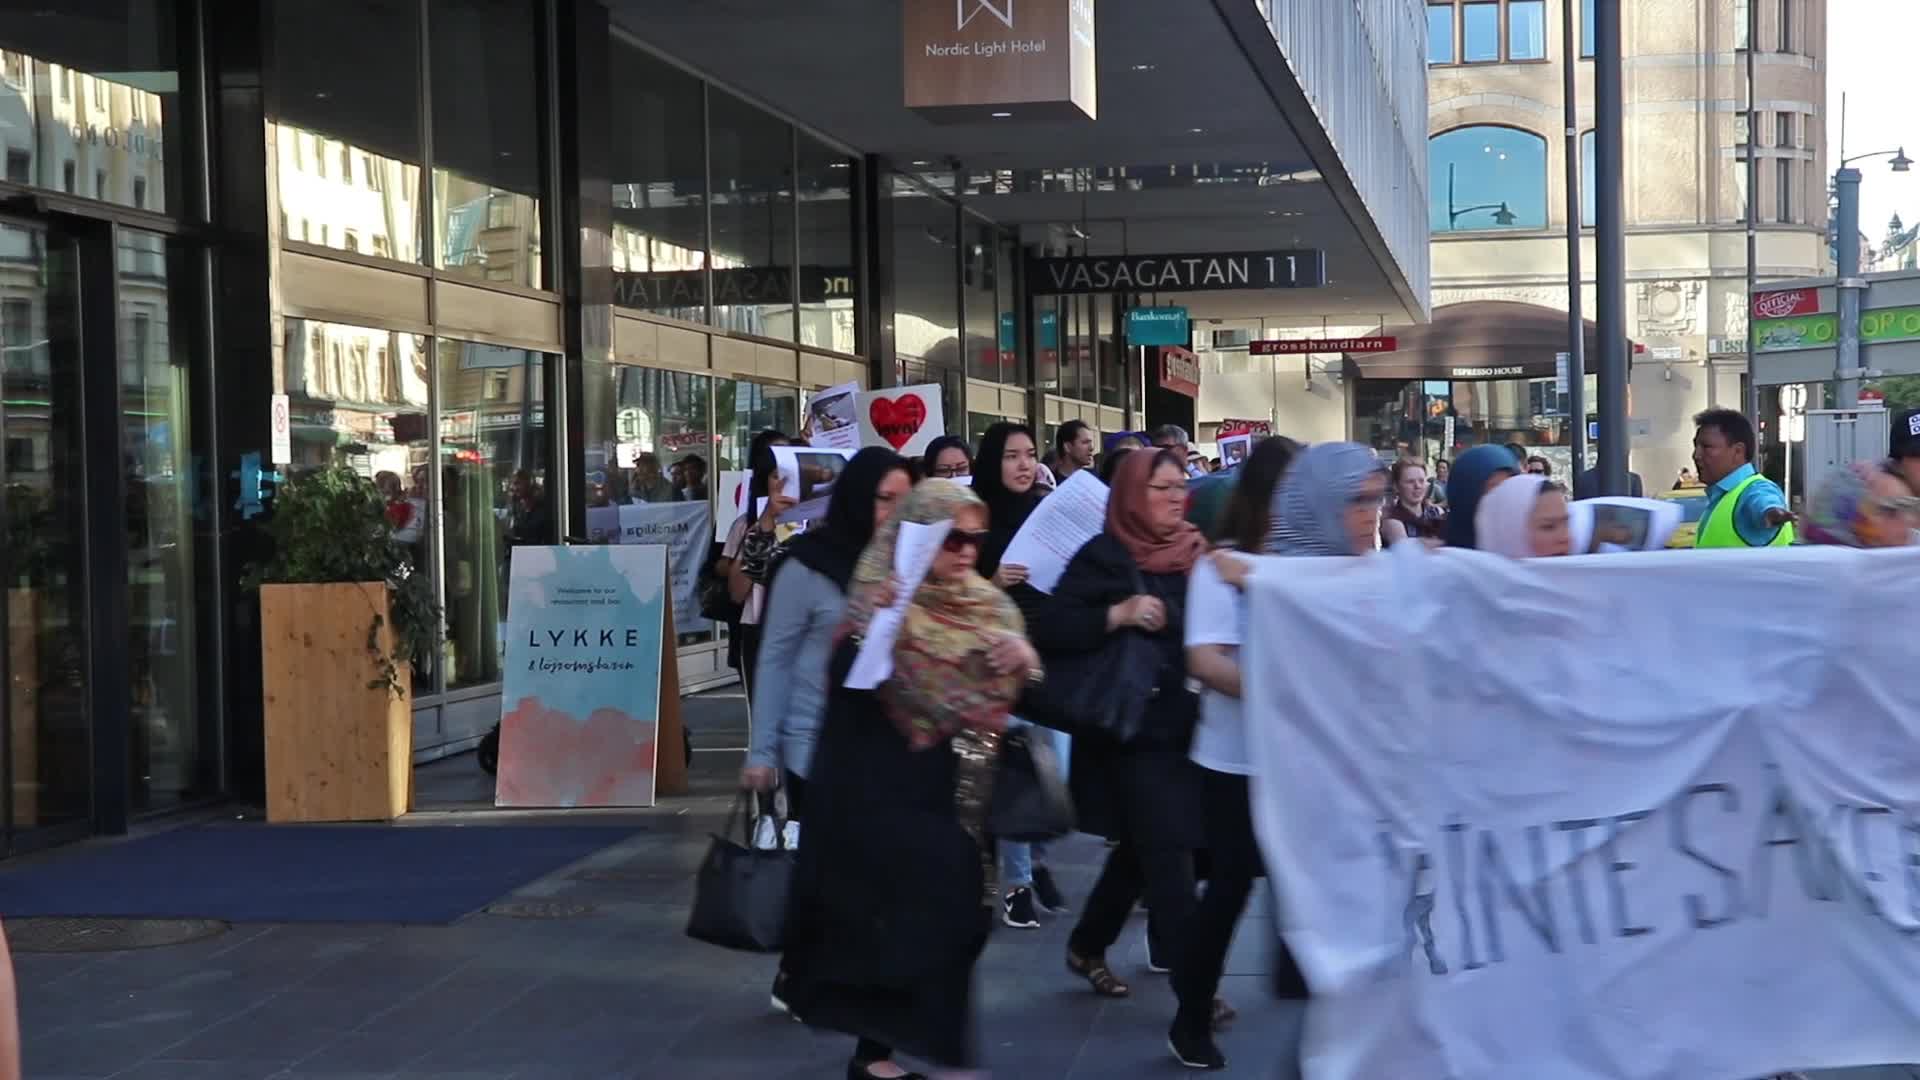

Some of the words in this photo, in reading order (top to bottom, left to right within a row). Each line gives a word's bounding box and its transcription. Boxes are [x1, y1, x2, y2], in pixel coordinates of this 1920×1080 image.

[926, 43, 970, 57] Nordic
[974, 42, 1006, 57] Light
[1011, 40, 1046, 52] Hotel
[1049, 258, 1249, 289] VASAGATAN
[1265, 256, 1297, 283] 11
[1494, 366, 1523, 376] HOUSE
[529, 629, 638, 648] LYKKE
